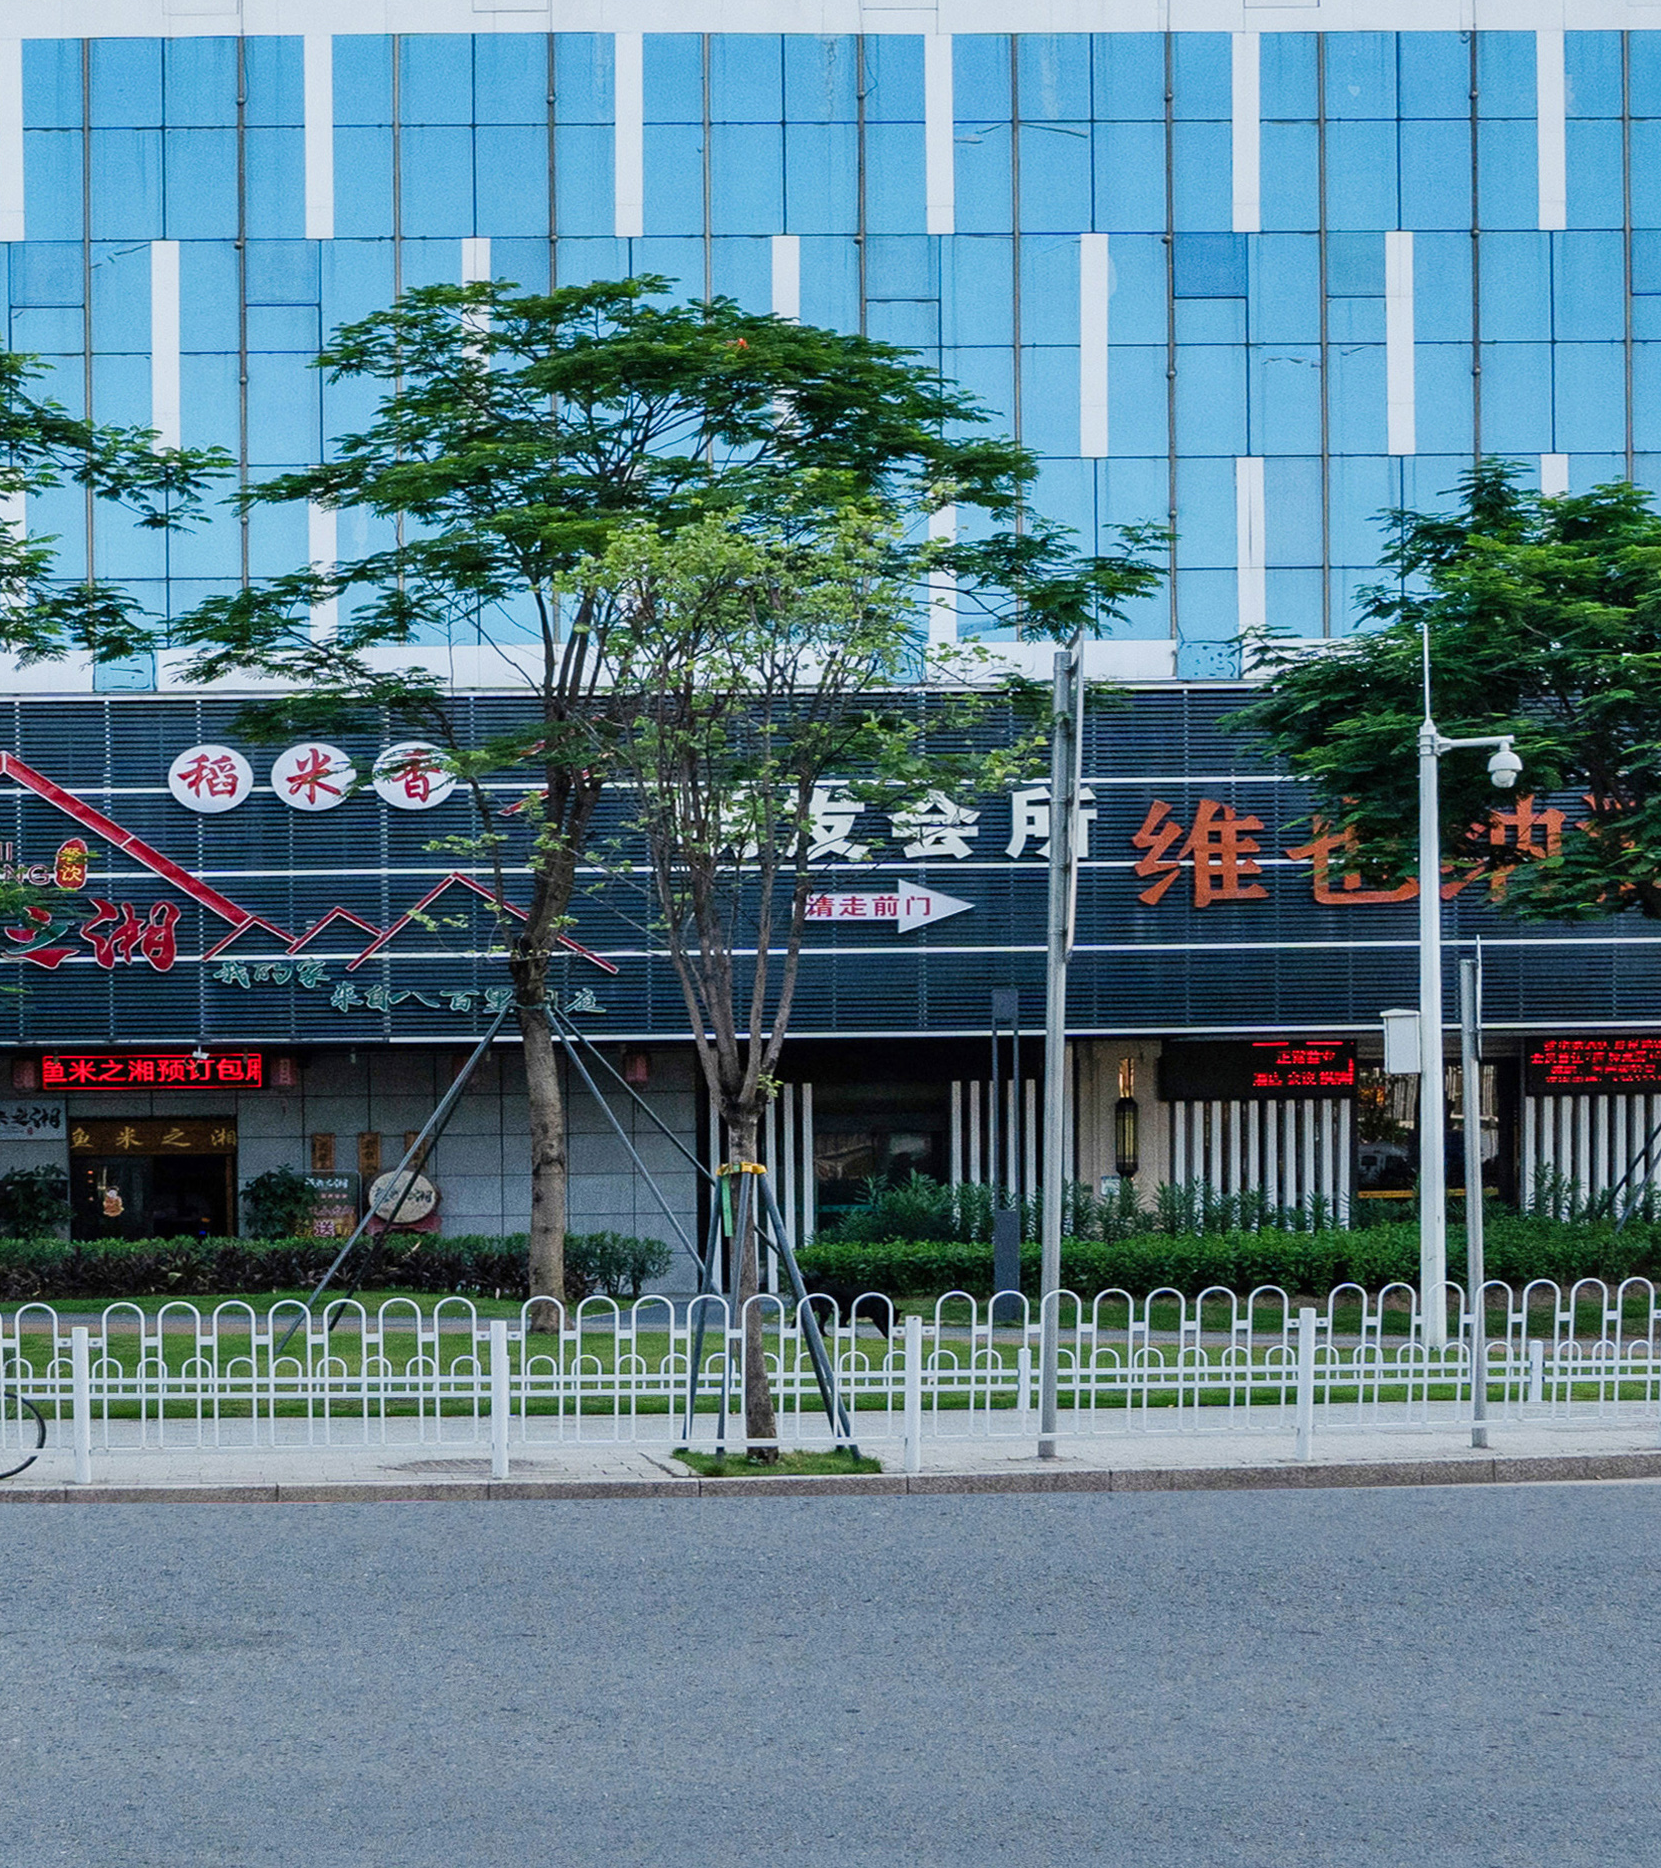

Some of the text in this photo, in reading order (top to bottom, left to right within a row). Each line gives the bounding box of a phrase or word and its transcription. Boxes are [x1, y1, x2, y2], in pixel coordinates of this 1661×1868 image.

[177, 748, 442, 805] 稻米香
[807, 895, 932, 918] 请走前门
[330, 981, 607, 1014] 来自八百里庭
[70, 1127, 236, 1149] 鱼米之湘
